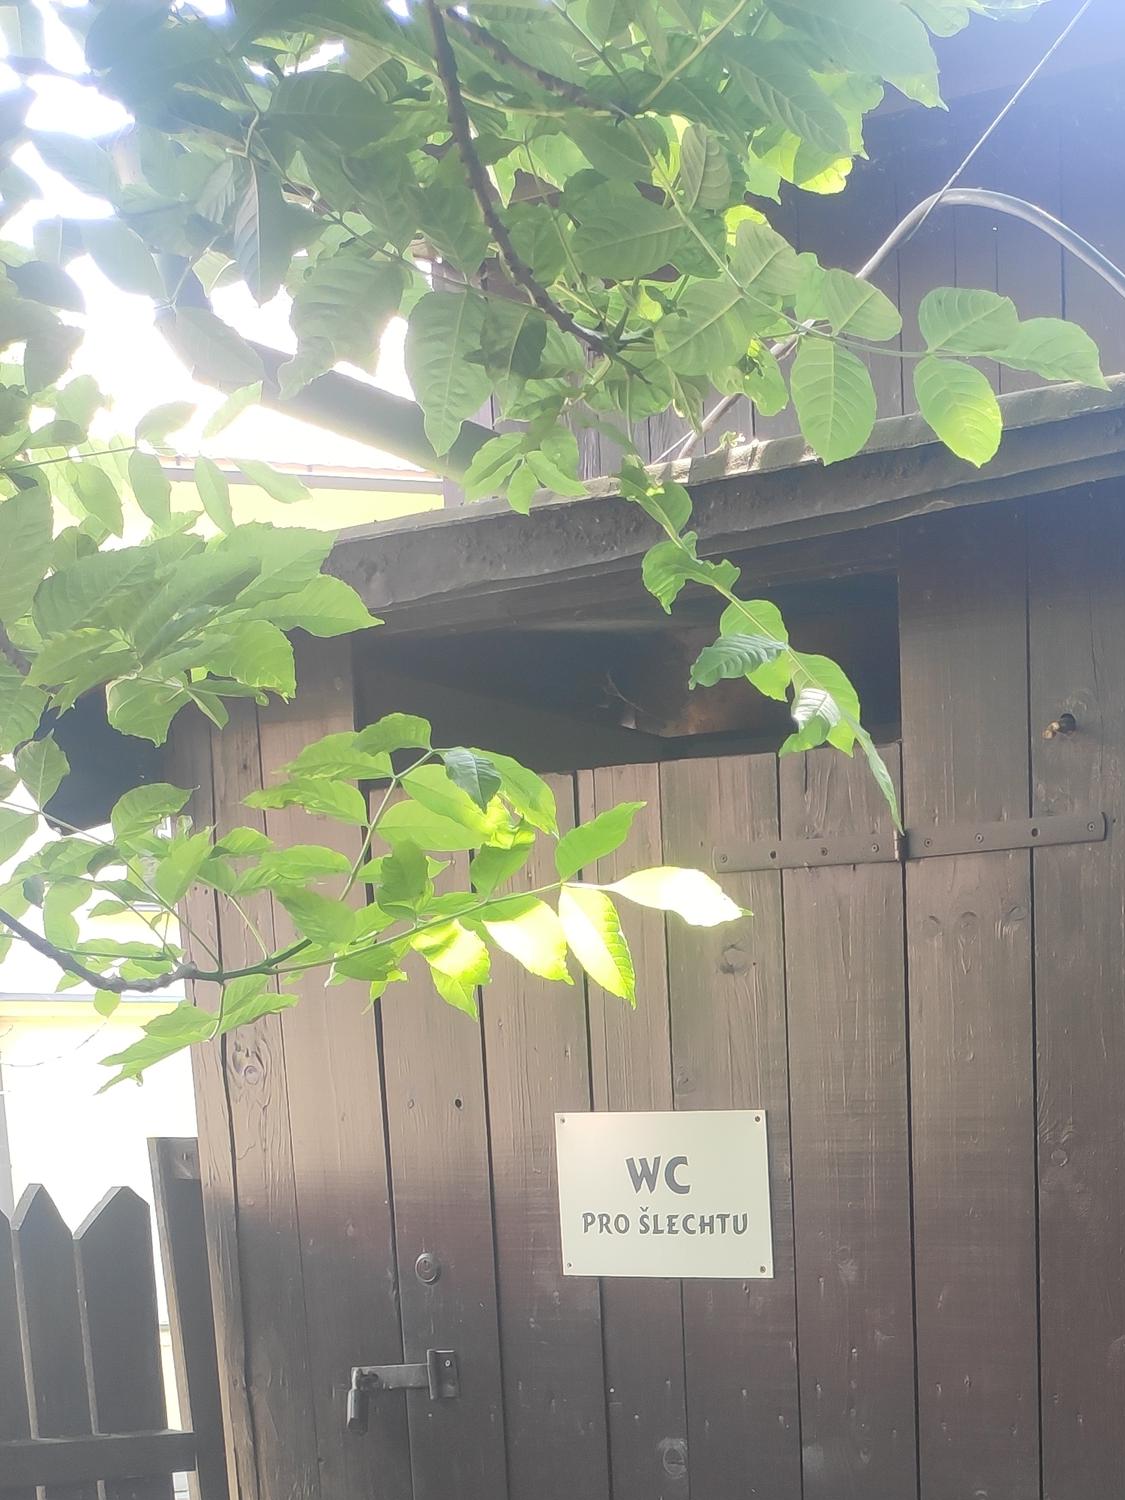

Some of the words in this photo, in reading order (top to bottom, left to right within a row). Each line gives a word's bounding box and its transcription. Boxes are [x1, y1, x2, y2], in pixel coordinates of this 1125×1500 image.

[625, 1155, 691, 1195] WC
[581, 1212, 630, 1235] PRO
[639, 1206, 748, 1235] ŠLECHTU
